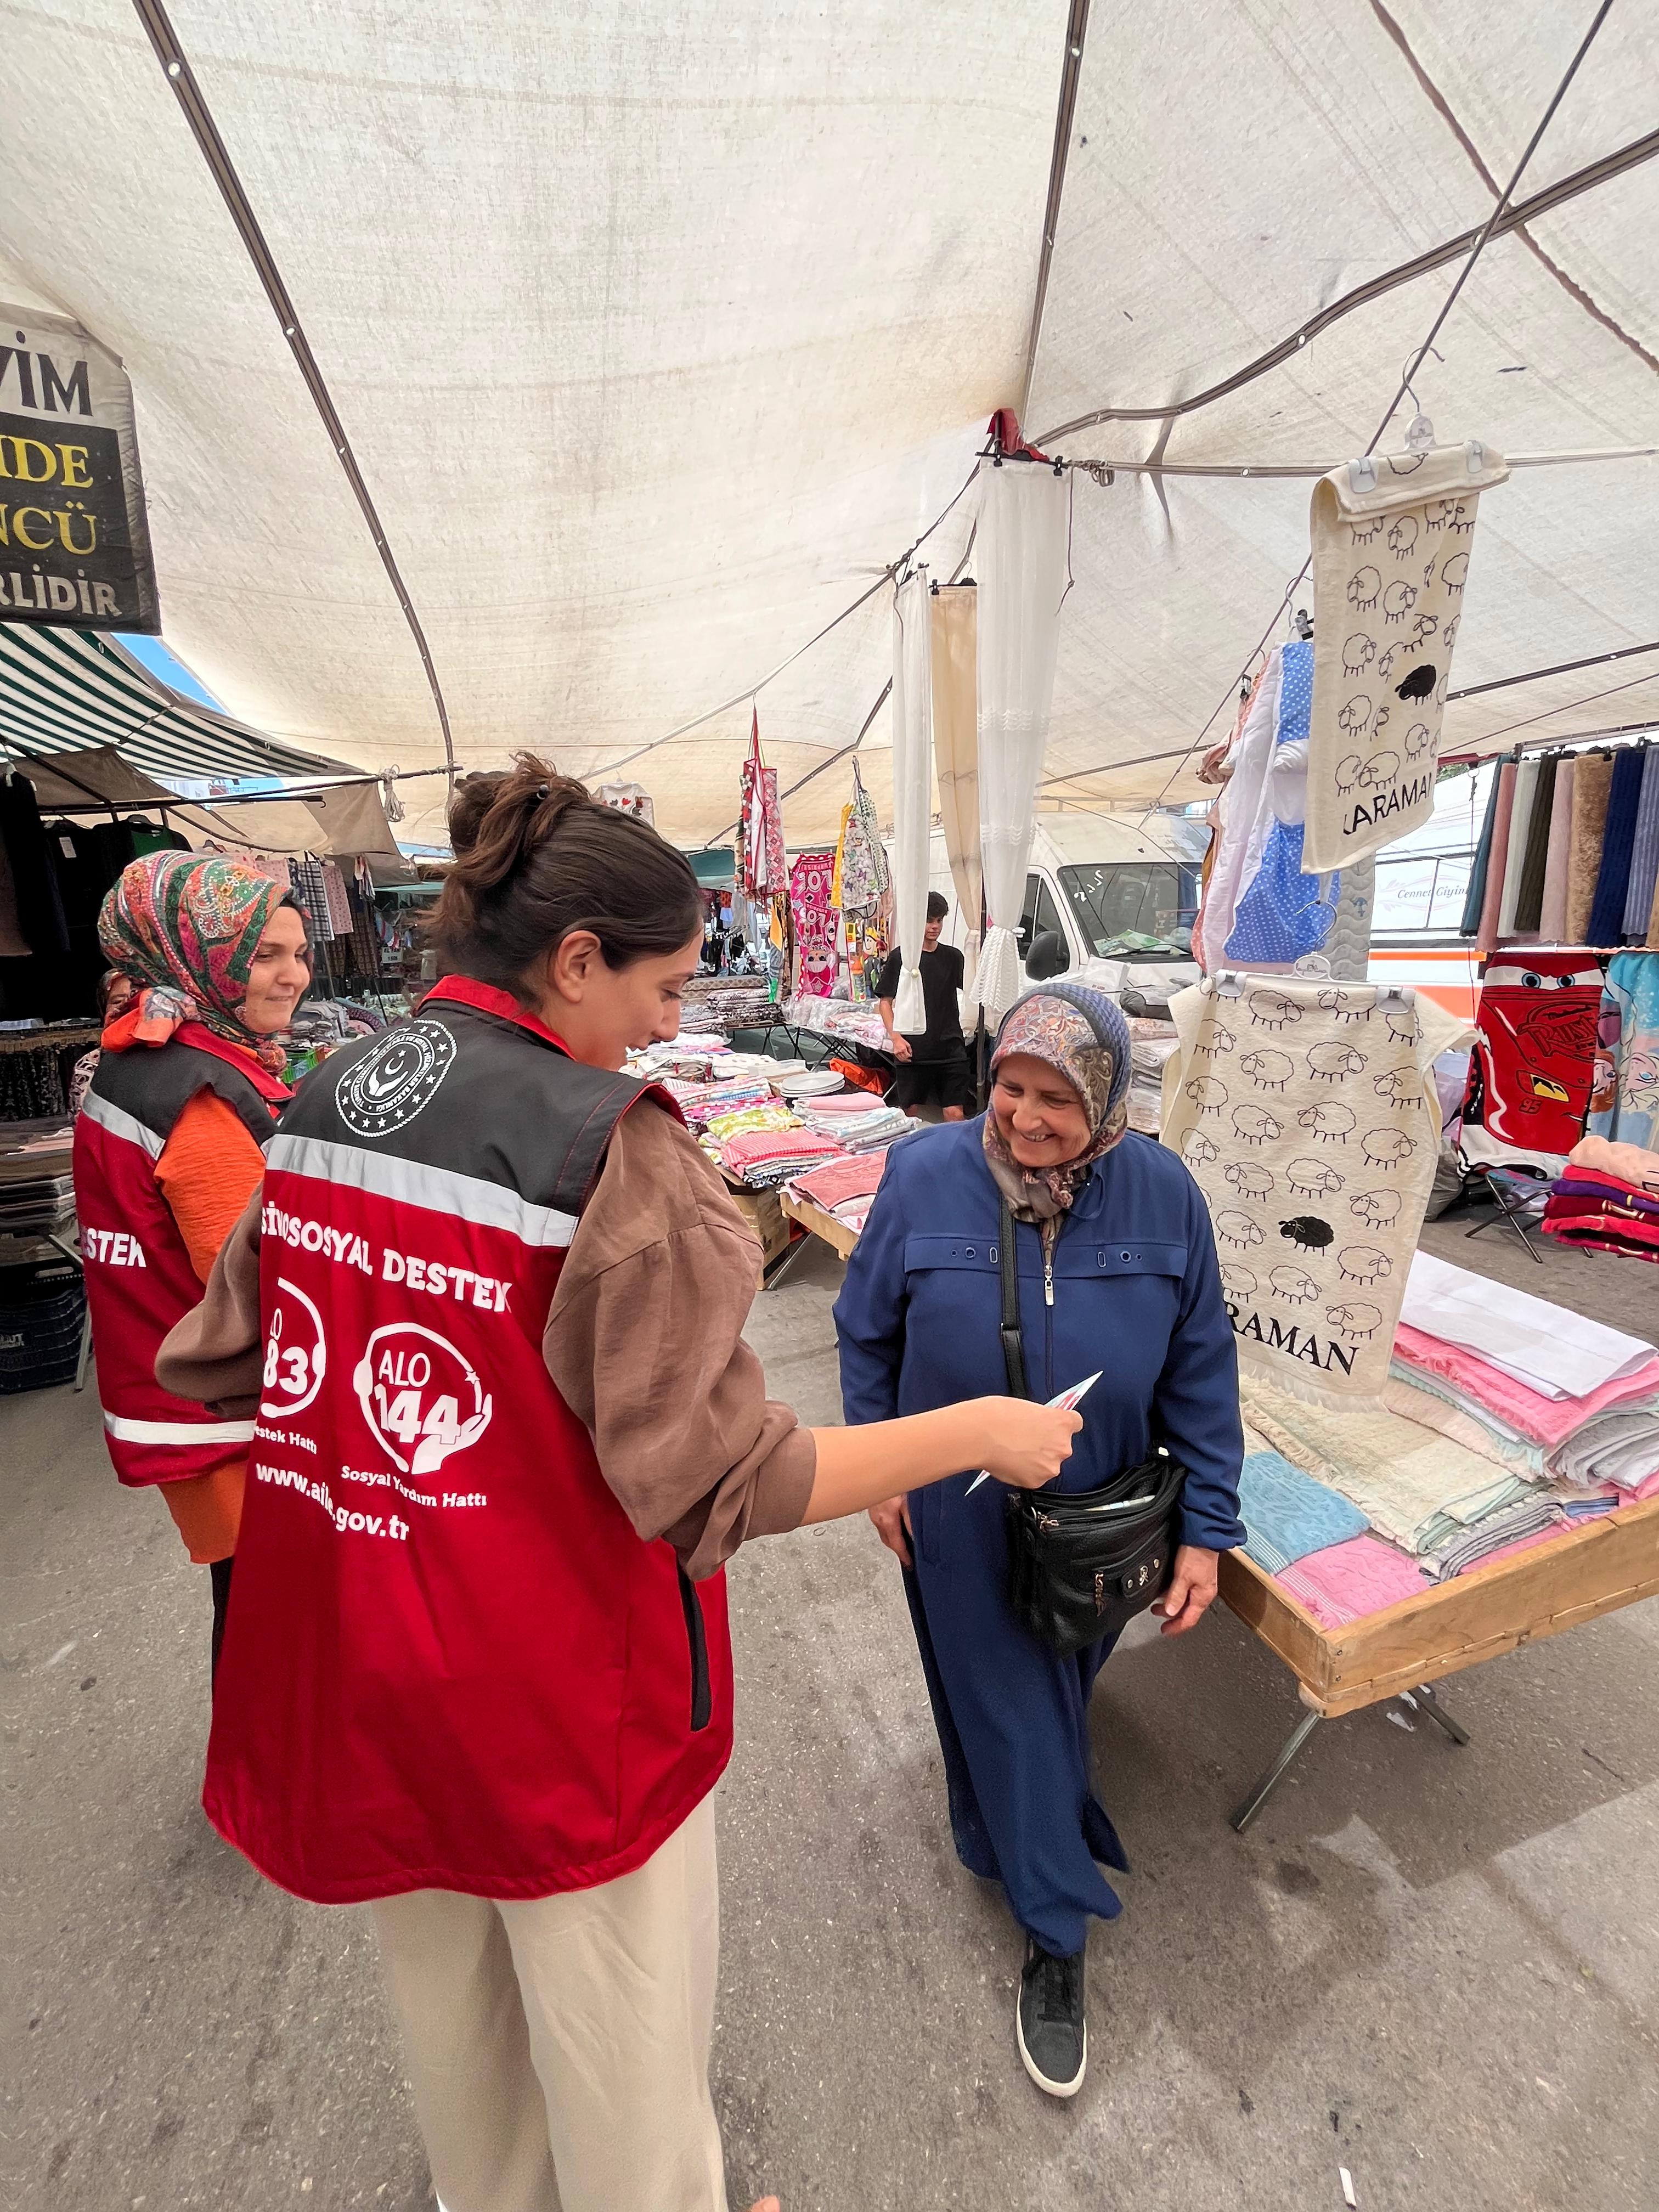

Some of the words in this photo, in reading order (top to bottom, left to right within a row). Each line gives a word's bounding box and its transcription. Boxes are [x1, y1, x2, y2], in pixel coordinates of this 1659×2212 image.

[1519, 1097, 1543, 1114] 95
[382, 1248, 512, 1313] DESTEK
[379, 1350, 431, 1387] ALO
[374, 1384, 461, 1444] 144
[256, 1463, 410, 1541] www.aile.gov.tr
[341, 1465, 391, 1487] Sosyal
[393, 1476, 437, 1507] Yardım
[442, 1492, 487, 1508] Hattı
